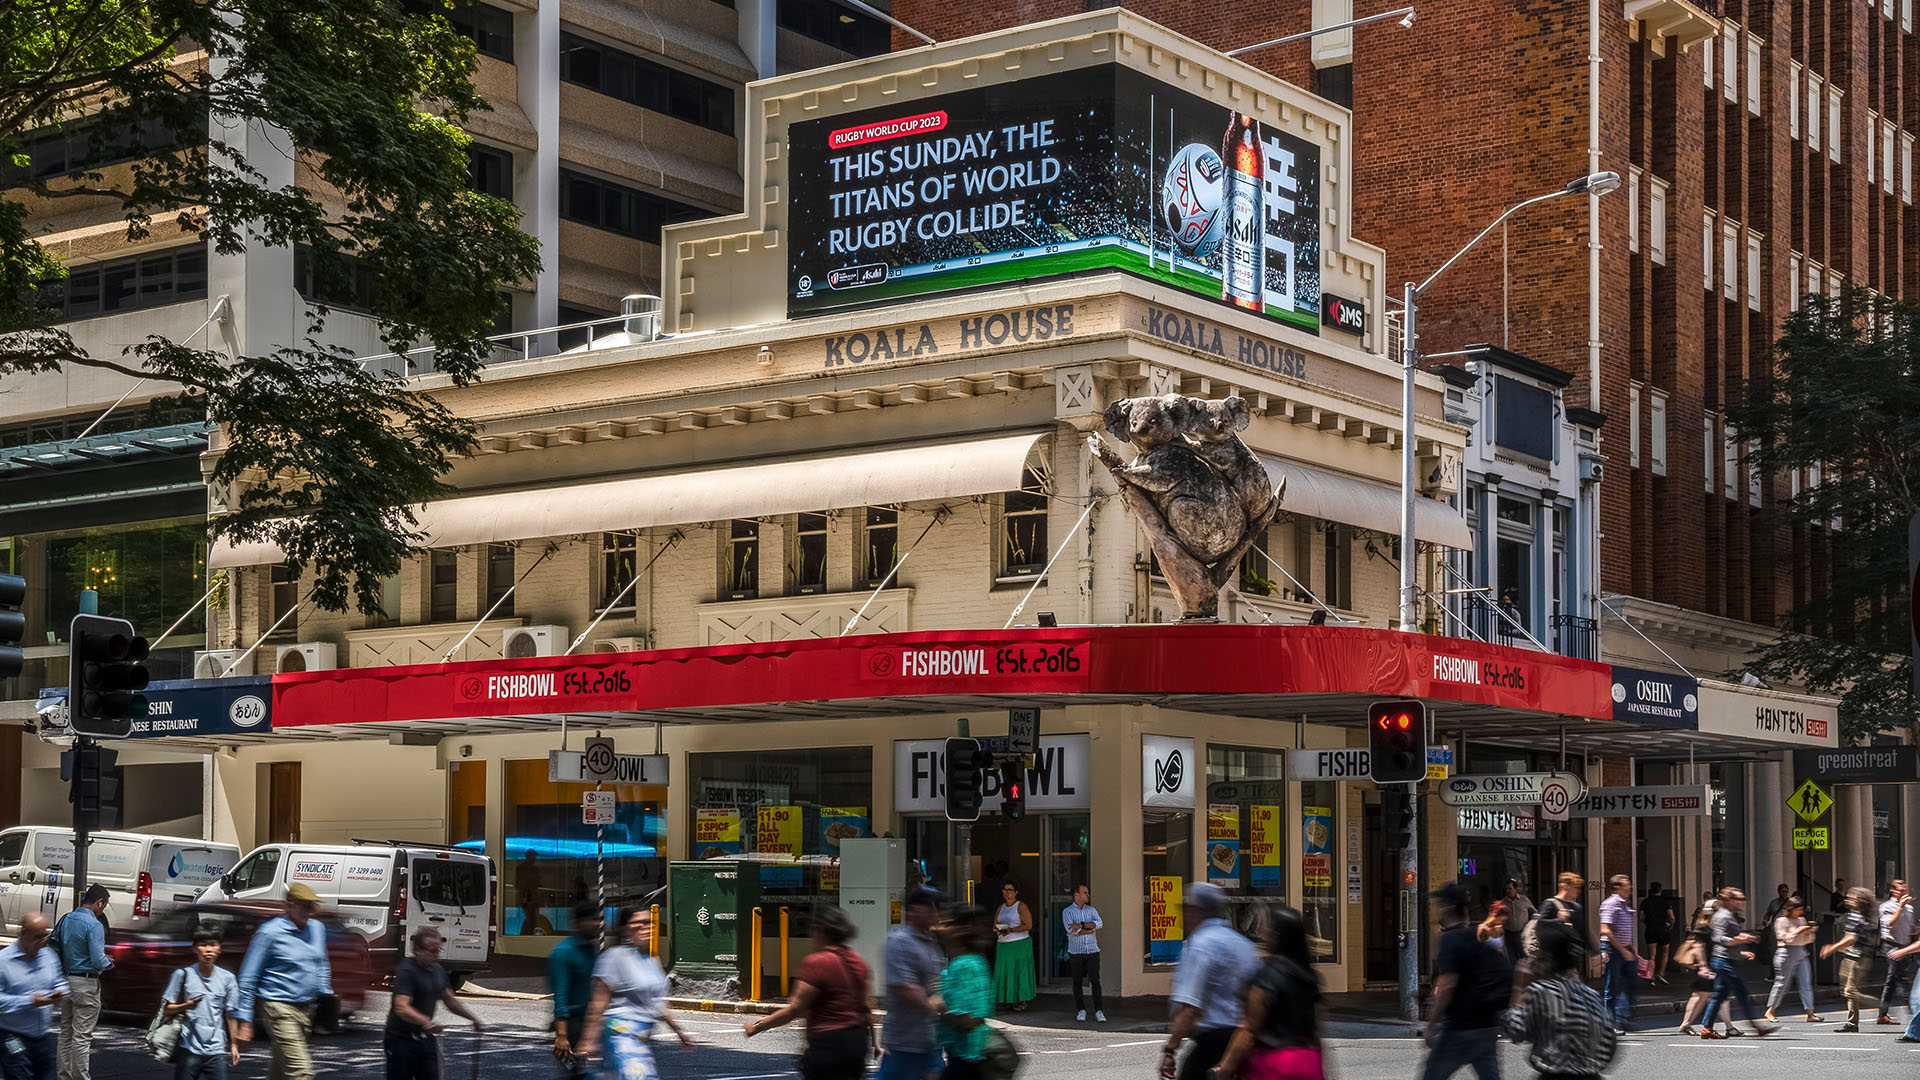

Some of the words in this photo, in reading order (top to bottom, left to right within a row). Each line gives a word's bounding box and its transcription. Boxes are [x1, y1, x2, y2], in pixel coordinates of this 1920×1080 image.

[835, 130, 864, 145] RUGBY
[865, 124, 899, 138] WORLD
[900, 120, 918, 133] CUP
[920, 116, 940, 129] 2023
[830, 149, 885, 183] THIS
[889, 130, 997, 174] SUNDAY,
[1002, 120, 1055, 153] THE
[830, 180, 915, 219] TITANS
[920, 174, 957, 203] OF
[962, 157, 1060, 196] WORLD
[830, 218, 913, 255] RUGBY
[916, 199, 1026, 241] COLLIDE
[825, 324, 938, 367] KOALA
[960, 304, 1074, 348] HOUSE
[1147, 306, 1224, 356] KOALA
[1238, 335, 1306, 379] HOUSE
[902, 650, 989, 676] FISHBOWL
[1433, 655, 1480, 685] FISHBOWL
[488, 674, 558, 699] FISHBOWL
[1636, 679, 1672, 704] OSHIN
[148, 701, 173, 716] SHIN
[1628, 702, 1651, 714] JAPANESE
[1651, 706, 1682, 718] RESTAURANT
[1013, 712, 1032, 723] ONE
[1755, 706, 1804, 735] HONTEN
[1808, 720, 1827, 737] SUSHI
[131, 719, 150, 732] NESE
[152, 718, 199, 731] RESTAURANT
[1012, 725, 1032, 737] WAY
[590, 750, 610, 766] 40
[1318, 751, 1370, 776] FISHB
[1818, 749, 1899, 774] greenstreat
[580, 754, 648, 782] FBOWL
[912, 746, 1076, 799] FIBWL
[1482, 776, 1534, 791] OSHIN
[705, 787, 734, 802] FISHBOWL
[736, 788, 766, 804] PRESENTS
[1454, 794, 1499, 802] JAPANESE
[1503, 793, 1542, 802] RESTAU
[1546, 792, 1565, 807] 40
[1664, 798, 1698, 808] SUSHI
[758, 810, 789, 822] 11.90
[1252, 810, 1271, 820] 11.90
[698, 823, 702, 832] 5
[704, 822, 729, 832] SPICE
[758, 822, 779, 833] ALL
[1208, 818, 1226, 828] MISO
[1252, 820, 1264, 831] ALL
[1516, 818, 1535, 830] SUSHI
[697, 832, 720, 841] BEEF.
[758, 833, 780, 844] DAY
[1252, 832, 1266, 842] DAY
[1795, 830, 1826, 838] REFUGE
[758, 844, 793, 854] EVERY
[1252, 843, 1274, 854] EVERY
[1796, 839, 1825, 847] ISLAND
[58, 846, 76, 854] thinkin
[1252, 854, 1266, 864] DAY
[1304, 858, 1326, 867] LEMON
[183, 863, 224, 876] waterlogic
[296, 863, 334, 874] SYNDICATE
[348, 866, 355, 874] 07
[356, 867, 370, 875] 3299
[370, 868, 384, 876] 0400
[1458, 858, 1476, 874] PEN
[1152, 881, 1173, 892] 11.90
[1152, 892, 1166, 904] ALL
[1152, 904, 1167, 916] DAY
[1152, 916, 1176, 928] EVERY
[1152, 928, 1167, 940] DAY
